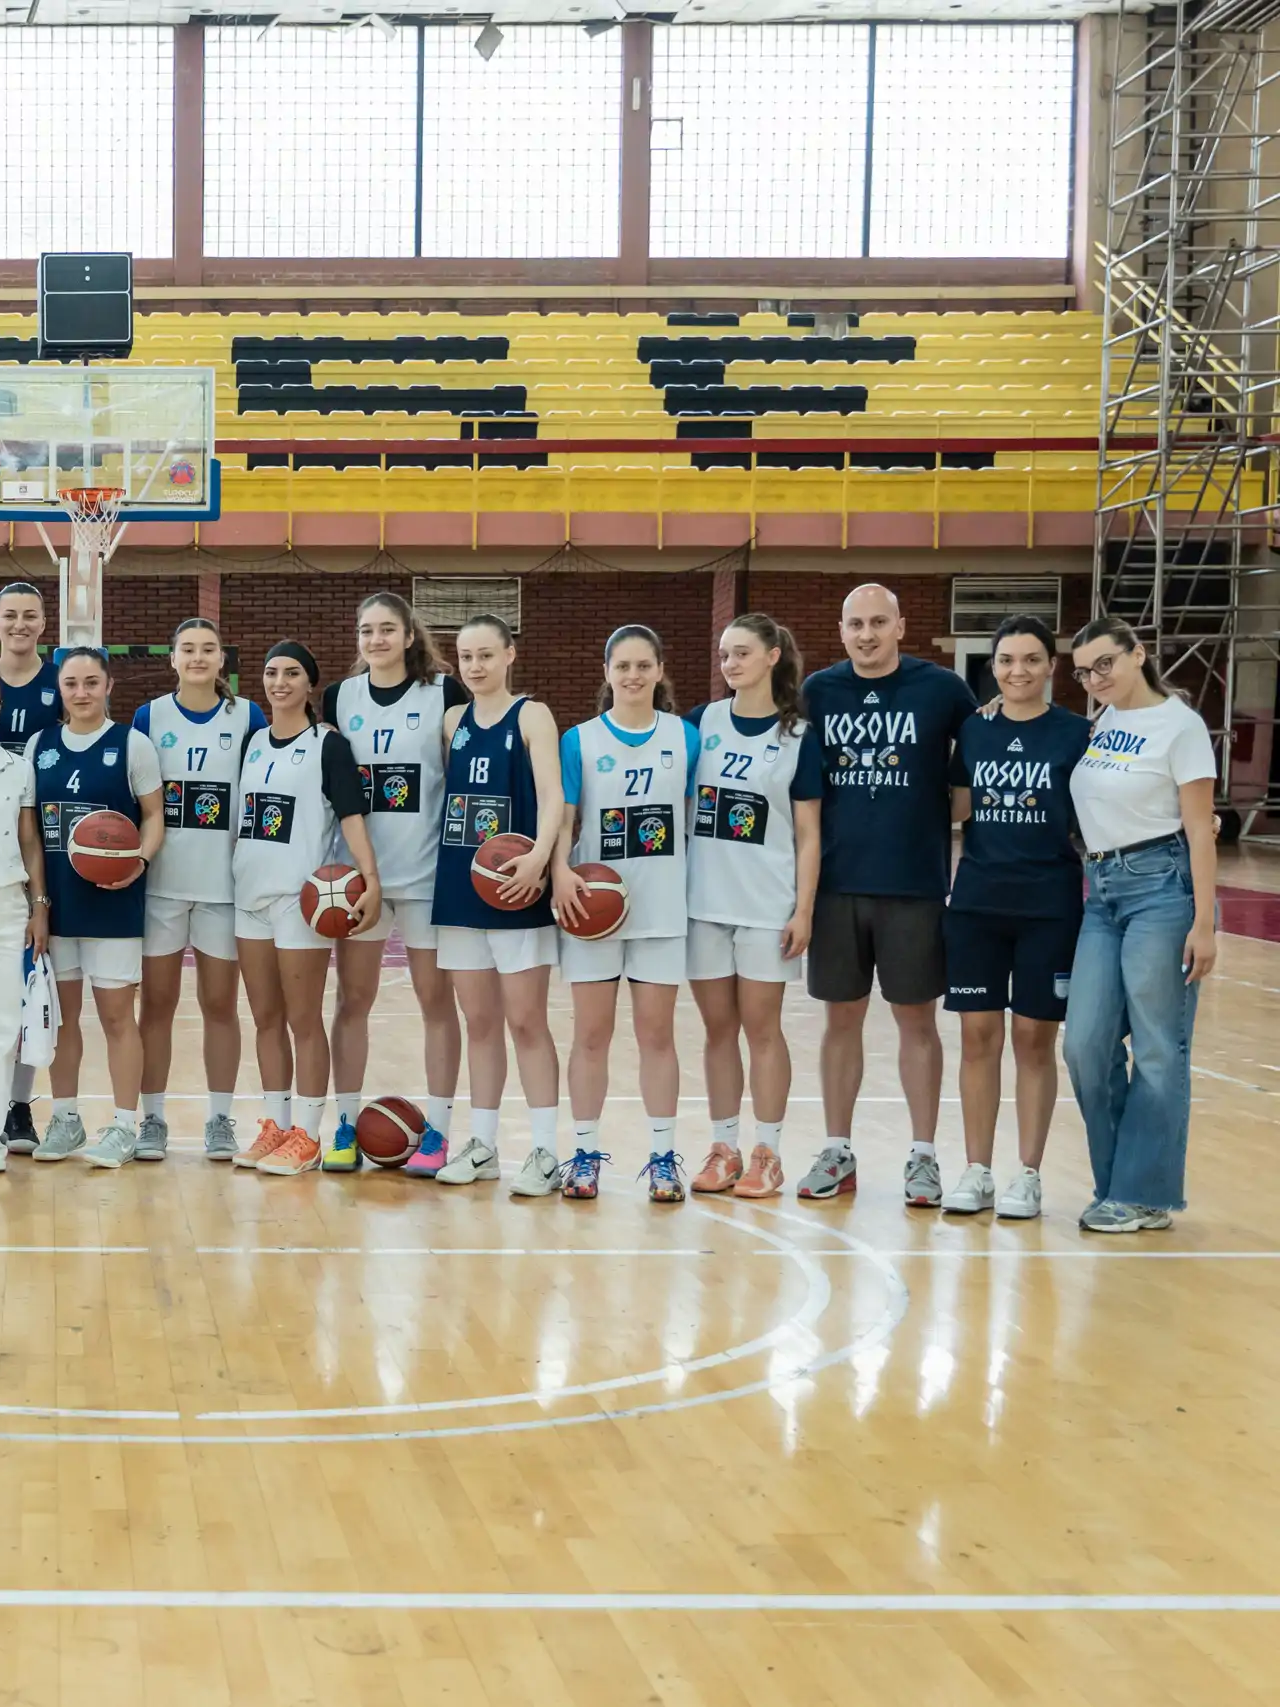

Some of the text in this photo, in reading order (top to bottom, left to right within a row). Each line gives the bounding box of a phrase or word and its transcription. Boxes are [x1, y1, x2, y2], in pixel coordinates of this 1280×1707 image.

[11, 708, 26, 732] 11
[824, 711, 917, 747] KOSOVA
[372, 728, 394, 754] 17
[186, 747, 208, 771] 17
[468, 757, 490, 784] 18
[720, 752, 753, 781] 22
[66, 769, 81, 794] 4
[264, 761, 275, 784] 1
[624, 767, 654, 796] 27
[972, 760, 1052, 789] KOSOVA
[45, 830, 59, 839] FIBA
[603, 837, 622, 847] FIBA
